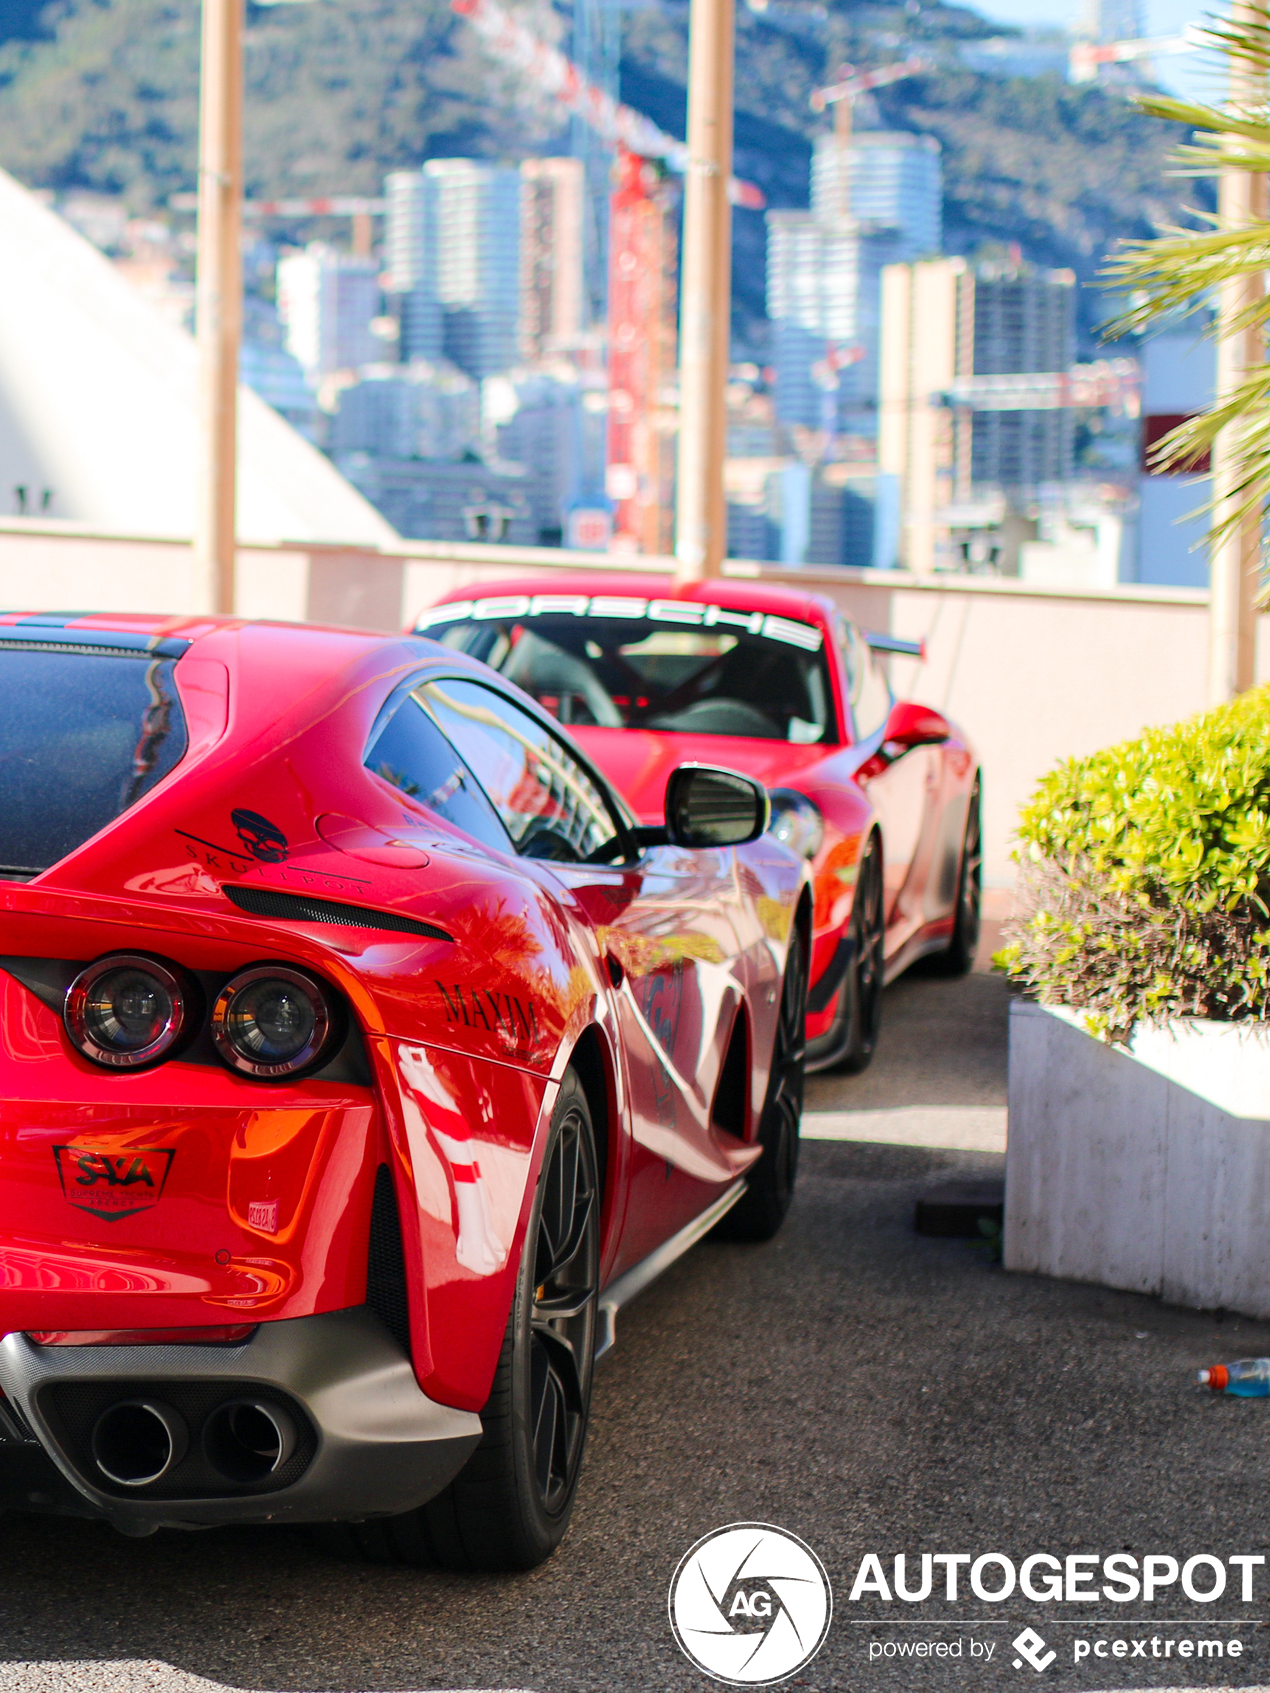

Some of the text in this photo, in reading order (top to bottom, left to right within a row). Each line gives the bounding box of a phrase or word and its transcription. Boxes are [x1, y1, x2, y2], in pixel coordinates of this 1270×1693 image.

[415, 594, 823, 653] PORSCHE
[185, 844, 371, 896] SKULLPOT
[433, 979, 540, 1044] MAXIM
[70, 1189, 114, 1198] SUPREME
[89, 1199, 135, 1207] AGENCY
